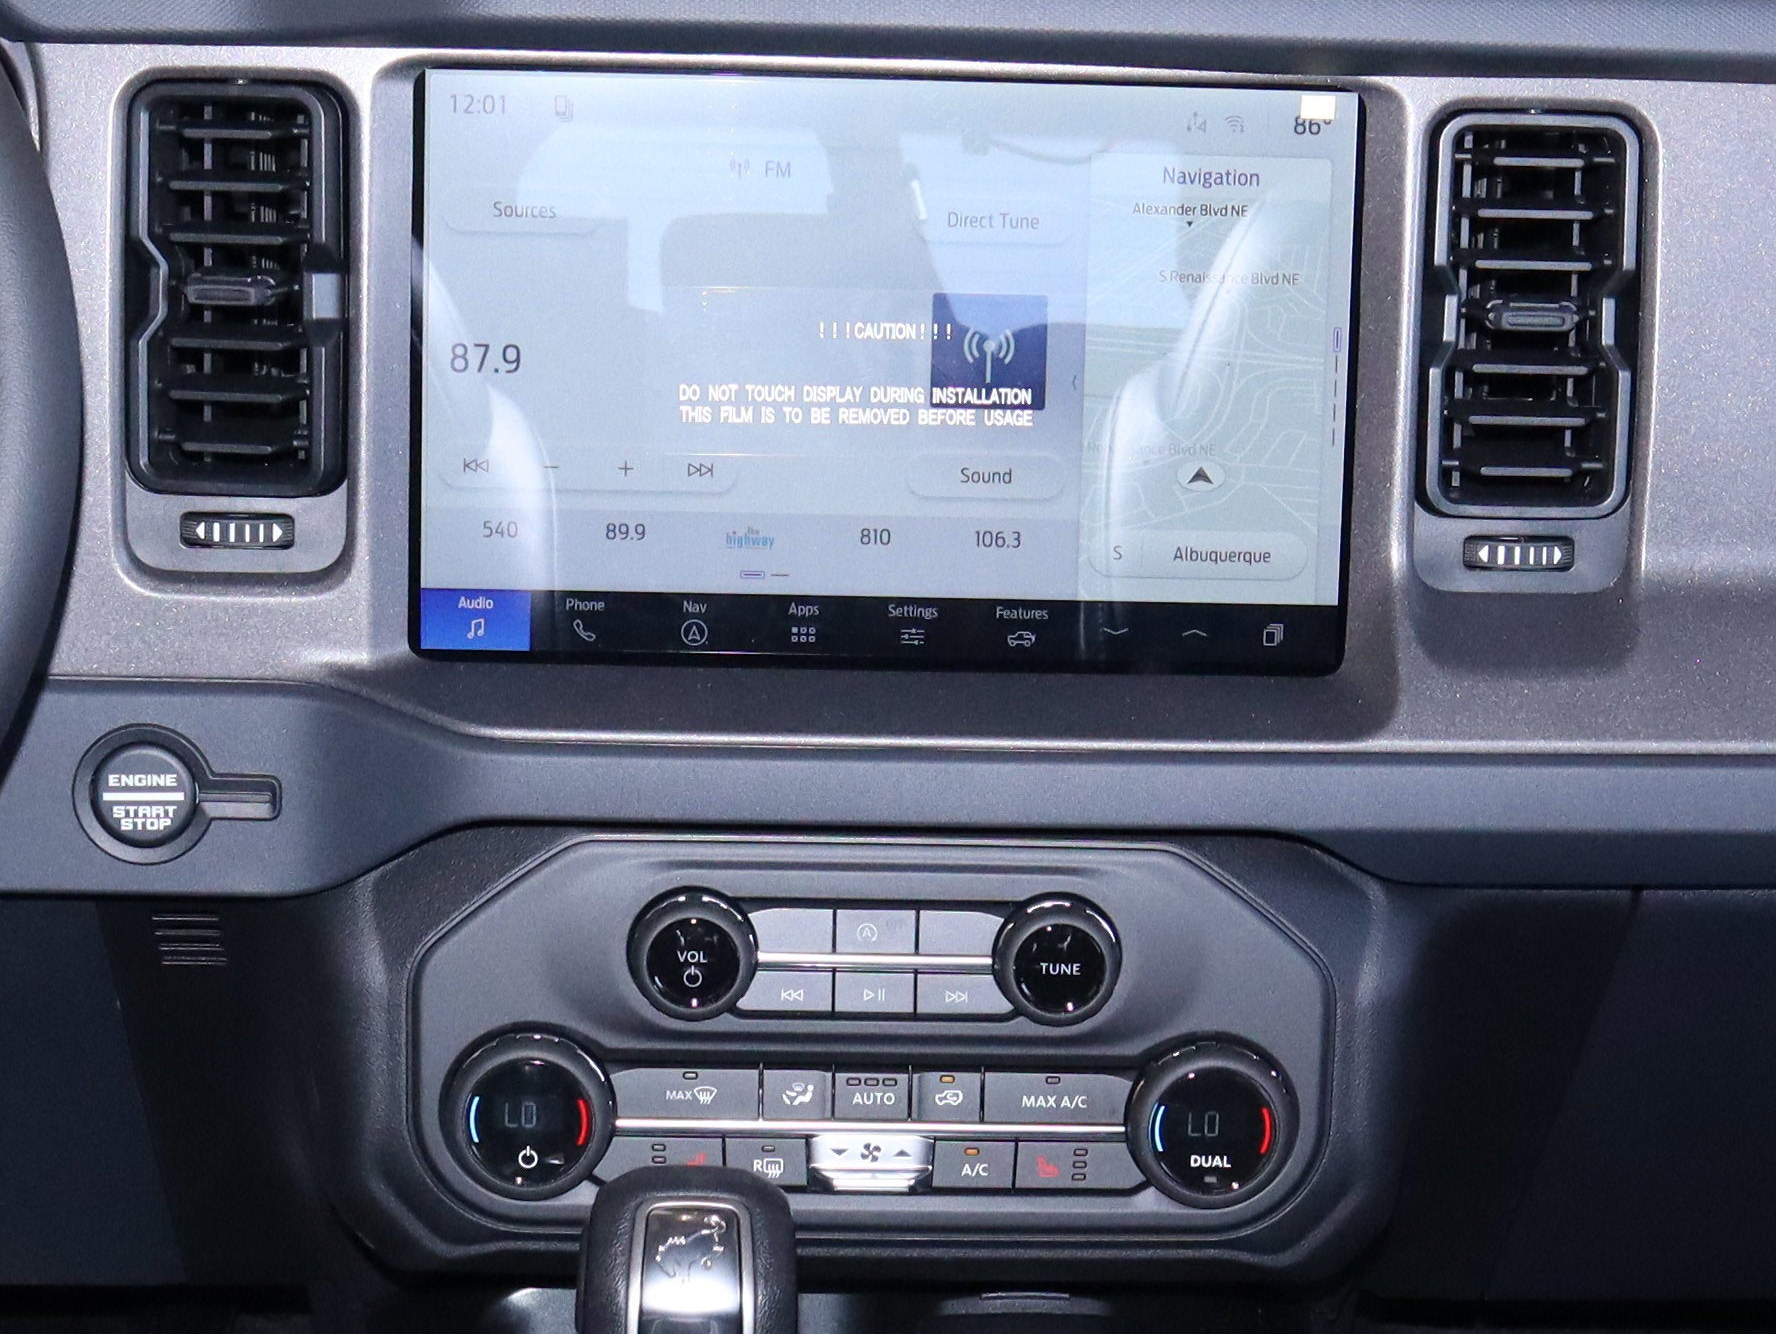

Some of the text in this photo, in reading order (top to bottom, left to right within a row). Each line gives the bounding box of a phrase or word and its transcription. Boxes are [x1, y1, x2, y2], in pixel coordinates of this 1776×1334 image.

[449, 94, 507, 115] 12:01
[765, 161, 792, 178] FM
[1162, 167, 1260, 189] Navigation
[493, 201, 556, 219] Sources
[1133, 202, 1249, 218] Alexander Blvd NE
[947, 211, 1040, 230] Direct Tune
[1251, 272, 1279, 285] Blvd
[1282, 273, 1301, 286] NE
[450, 342, 521, 373] 87.9
[679, 384, 1032, 405] DO NOT TOUCH DISPLAY DURING INSTALLATION
[679, 405, 1033, 426] THIS FILM IS TO BE REMOVED BEFORE USAGE
[960, 467, 1012, 484] Sound
[482, 521, 518, 538] 540
[605, 523, 646, 541] 89.9
[860, 528, 890, 546] 810
[726, 530, 775, 550] highway
[975, 530, 1021, 548] 106.3
[1113, 545, 1122, 560] S
[1173, 547, 1272, 565] Albuquerque
[458, 596, 494, 610] Audio
[565, 598, 605, 612] Phone
[683, 601, 707, 615] Nav
[788, 602, 819, 616] Apps
[888, 604, 938, 619] Settings
[996, 606, 1049, 620] Features
[108, 774, 177, 787] ENGINE
[112, 805, 177, 818] START
[120, 818, 172, 831] STOP
[678, 950, 707, 964] VOL
[1040, 962, 1081, 975] TUNE
[666, 1090, 692, 1100] MAX
[853, 1092, 895, 1106] AUTO
[1022, 1095, 1087, 1109] MAX A/C
[1187, 1112, 1220, 1138] LO
[1191, 1154, 1231, 1168] DUAL
[962, 1162, 989, 1177] A/C
